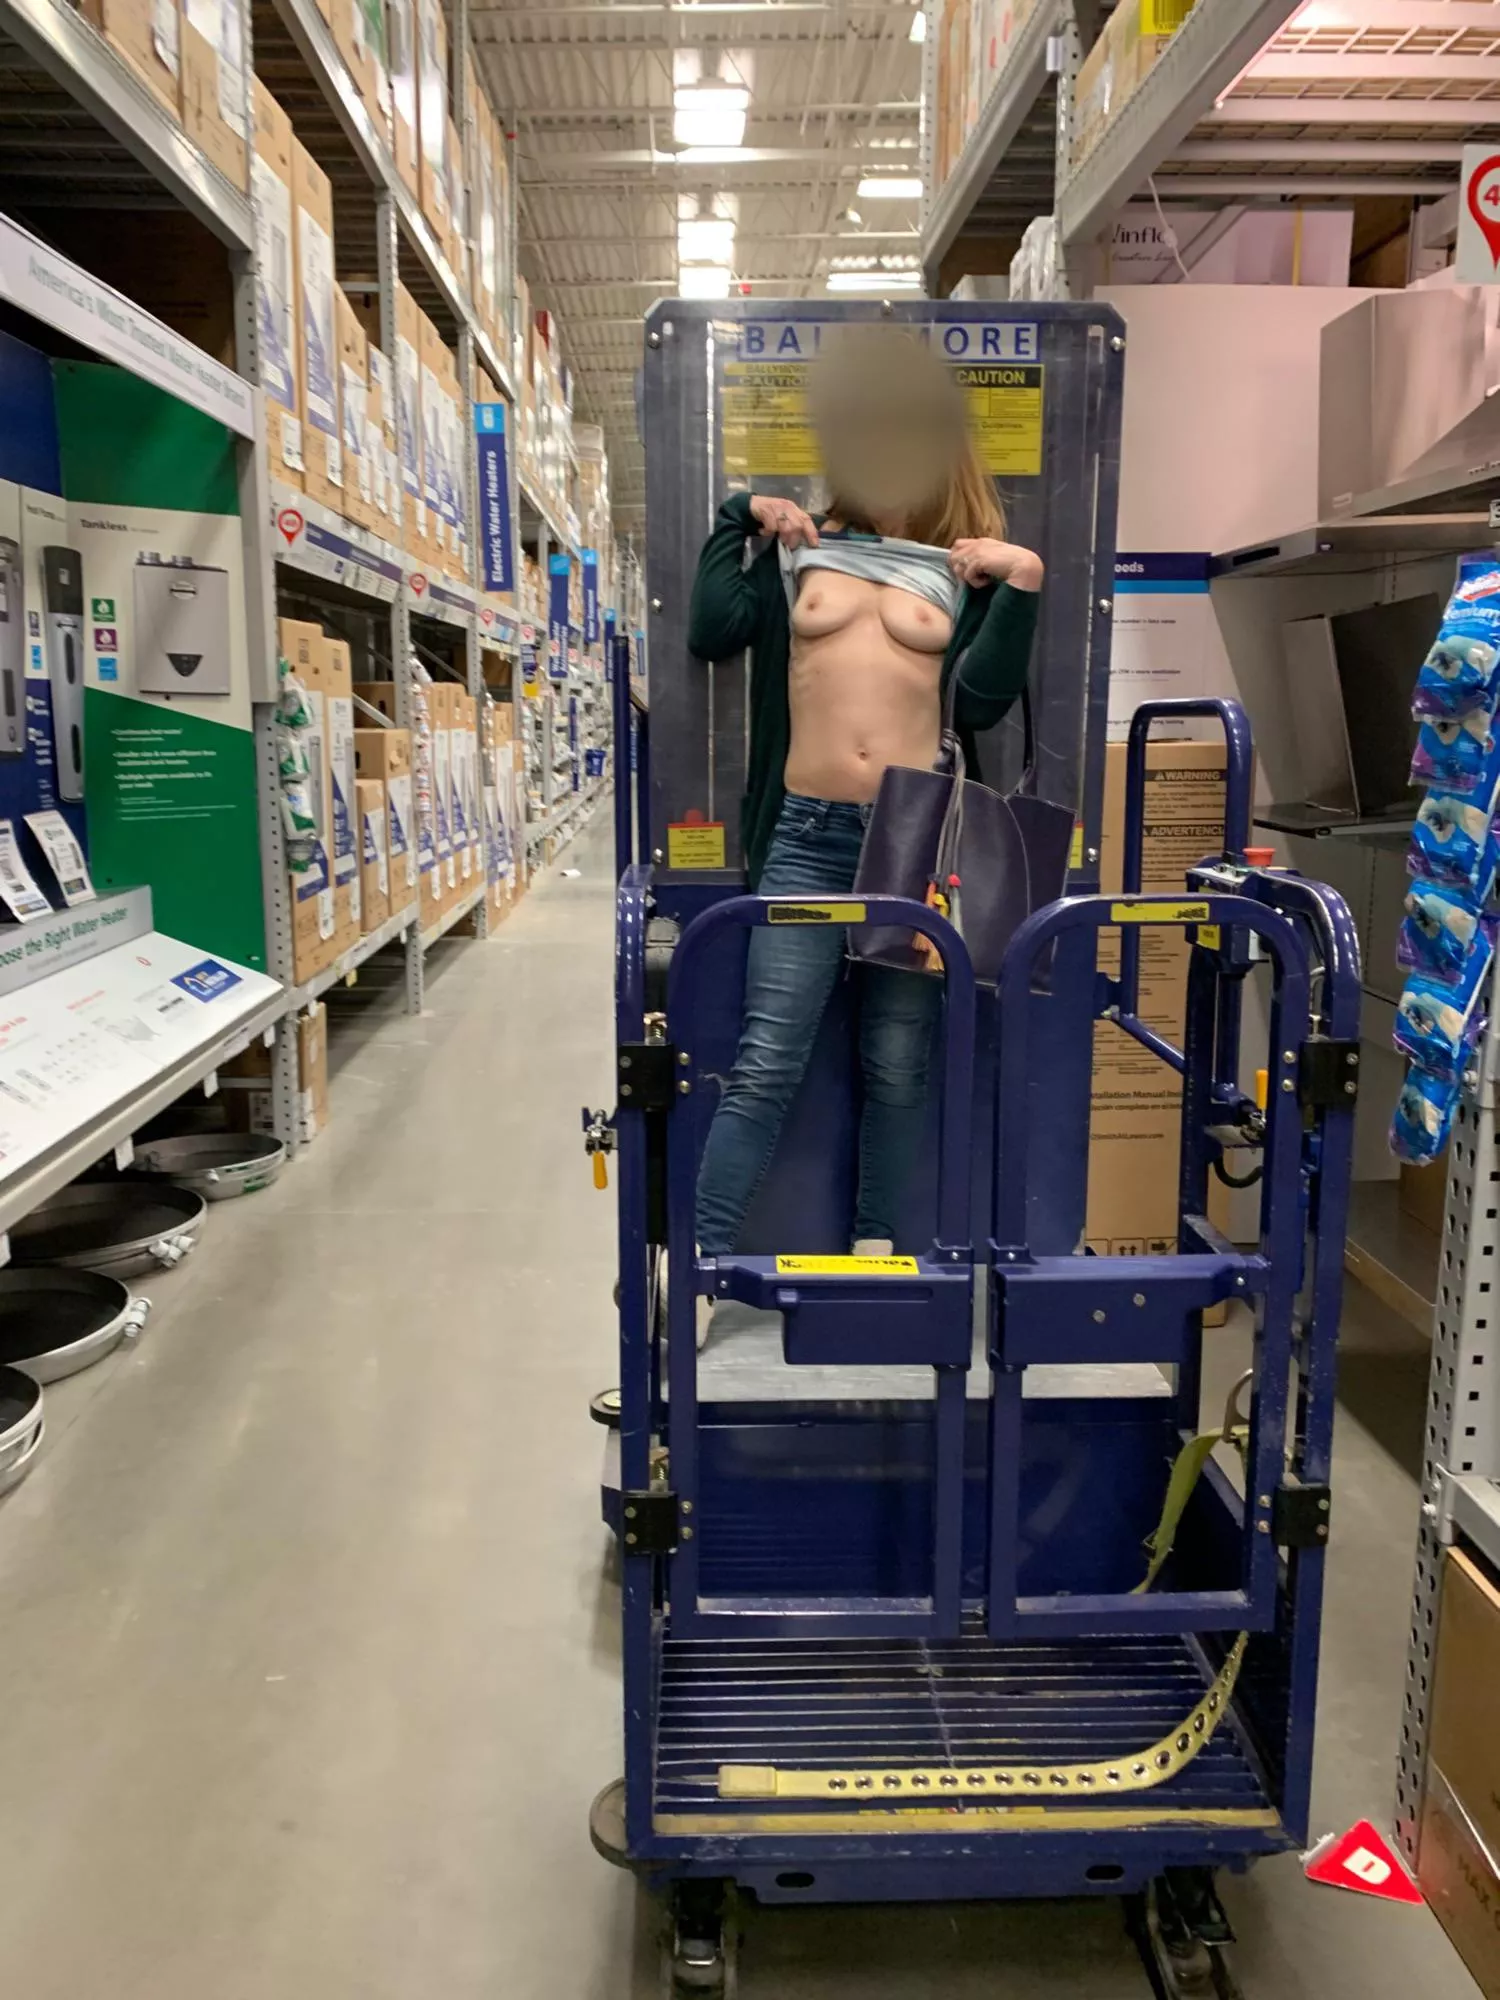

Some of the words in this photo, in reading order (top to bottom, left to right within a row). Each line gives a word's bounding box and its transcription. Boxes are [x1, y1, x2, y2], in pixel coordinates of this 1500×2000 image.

[957, 369, 1025, 385] CAUTION
[486, 450, 499, 499] Heaters
[80, 518, 128, 532] Tankless
[488, 500, 502, 536] Water
[490, 537, 504, 583] Electric
[1114, 561, 1145, 573] oods
[1166, 771, 1221, 780] WARNING
[1151, 826, 1224, 836] ADVERTENCI
[25, 937, 42, 956] the
[45, 926, 72, 950] Right
